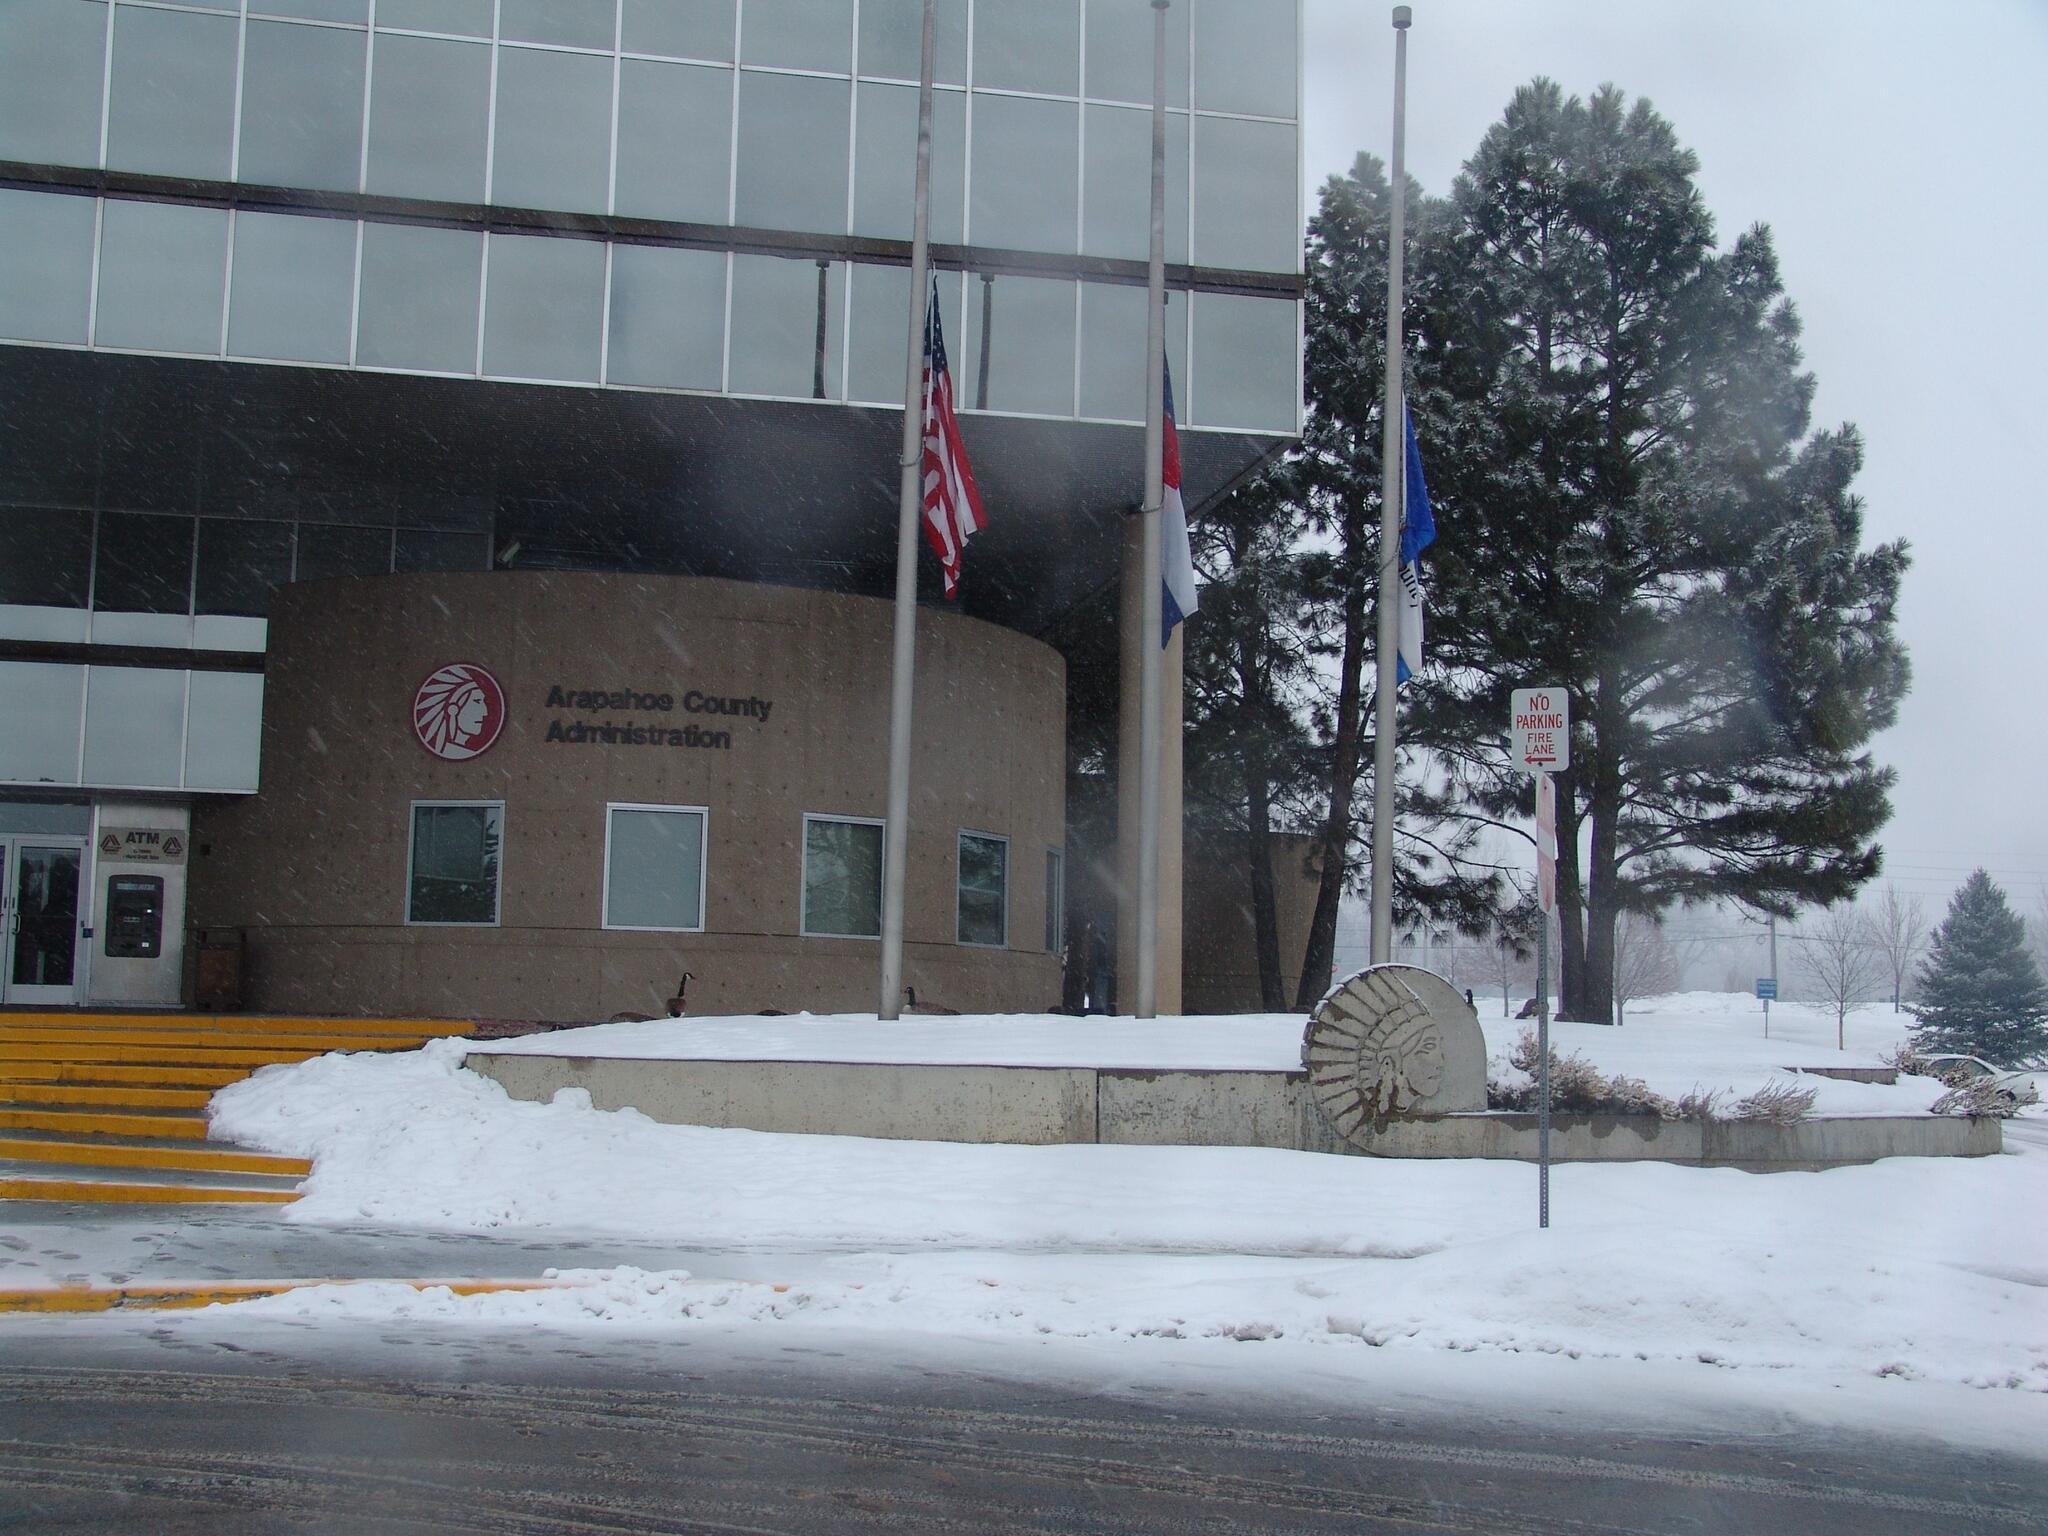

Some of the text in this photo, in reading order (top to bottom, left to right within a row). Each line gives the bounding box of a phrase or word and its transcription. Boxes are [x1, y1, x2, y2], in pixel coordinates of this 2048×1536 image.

[545, 685, 773, 722] Arapahoe County
[1529, 696, 1550, 711] NO
[1516, 714, 1563, 730] PARKING
[545, 719, 731, 750] Administration
[1527, 732, 1553, 743] FIRE
[1525, 744, 1555, 755] LANE
[125, 831, 160, 845] ATM
